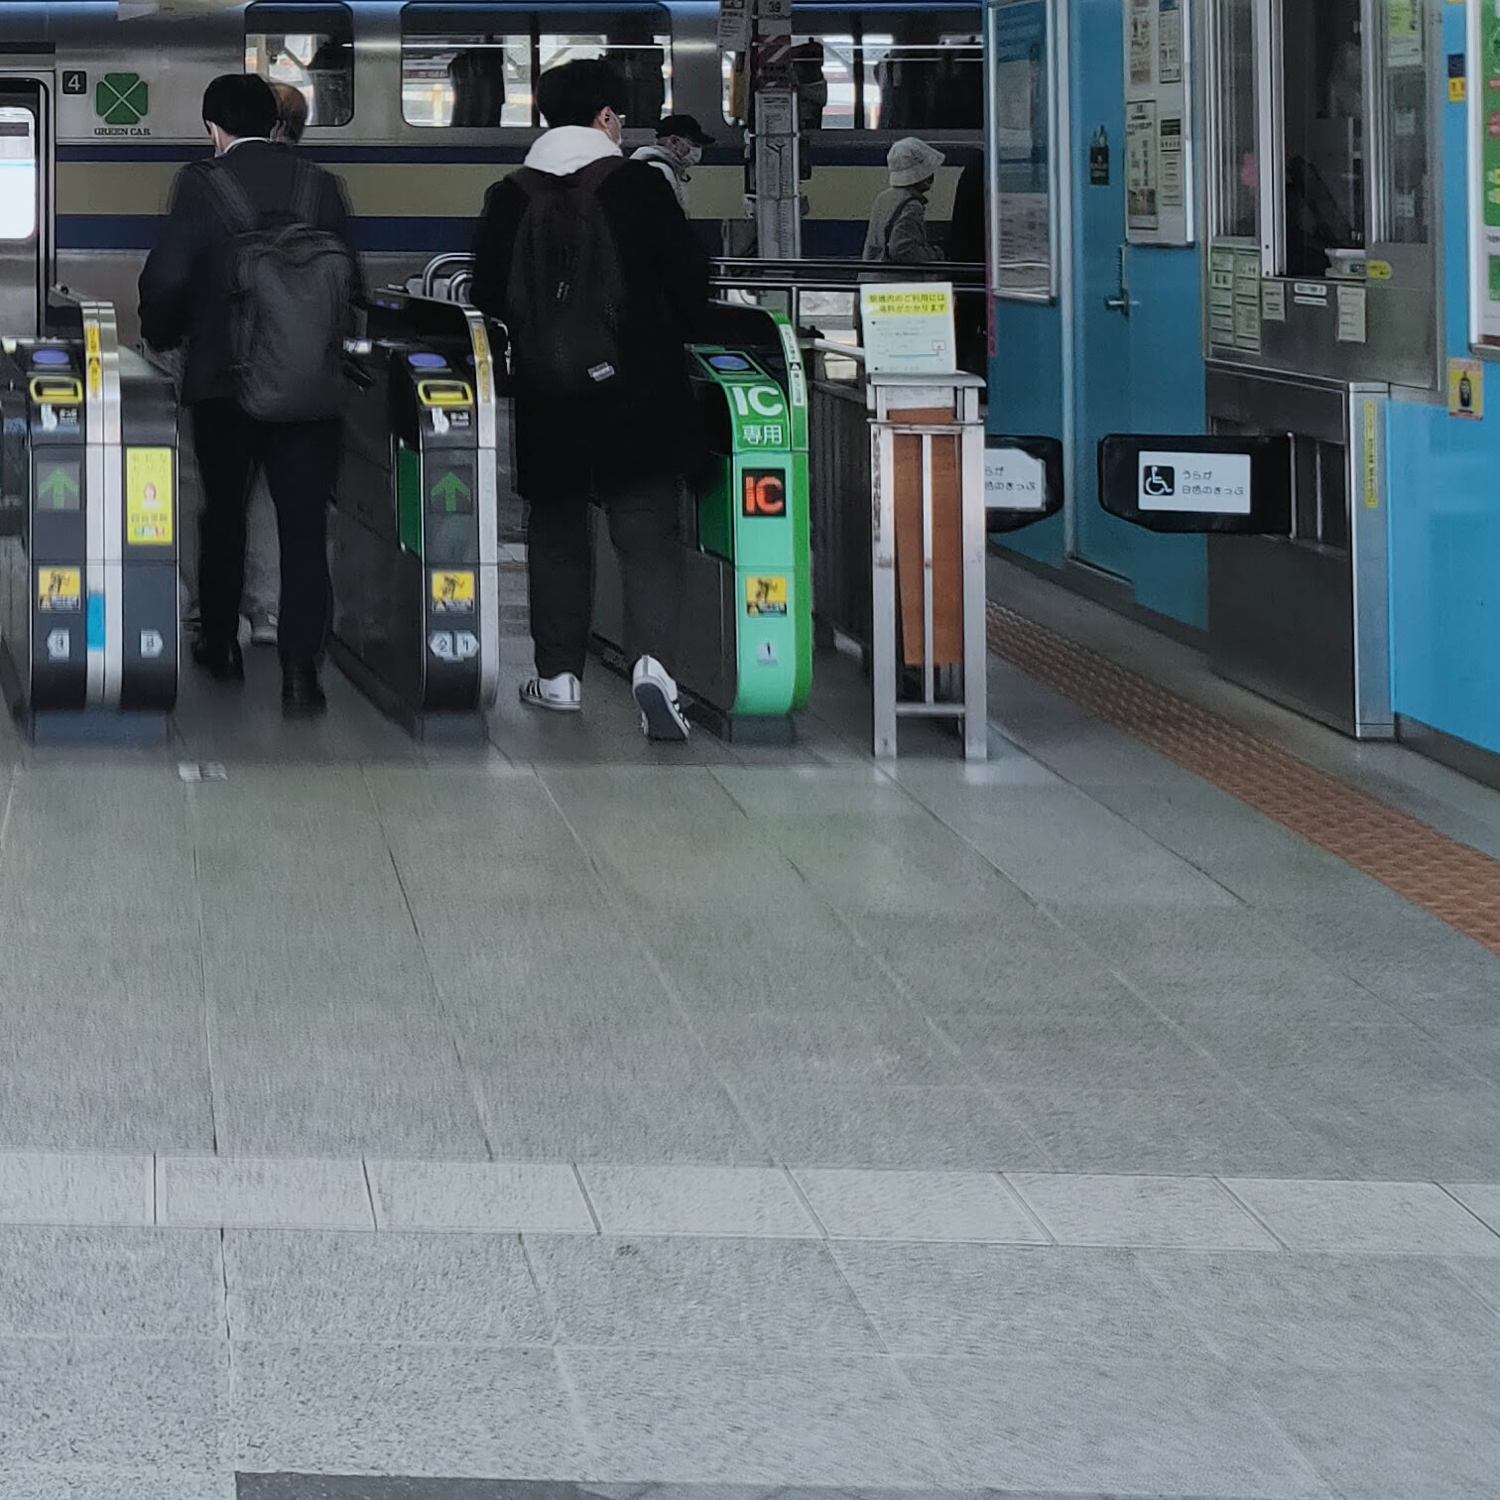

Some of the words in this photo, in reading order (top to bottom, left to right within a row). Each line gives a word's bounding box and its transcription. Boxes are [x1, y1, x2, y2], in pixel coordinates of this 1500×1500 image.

[68, 74, 81, 91] 4
[94, 128, 128, 136] GREEN
[130, 128, 151, 136] CAR
[732, 386, 783, 416] IC
[742, 425, 782, 445] 専用
[745, 476, 784, 514] IC
